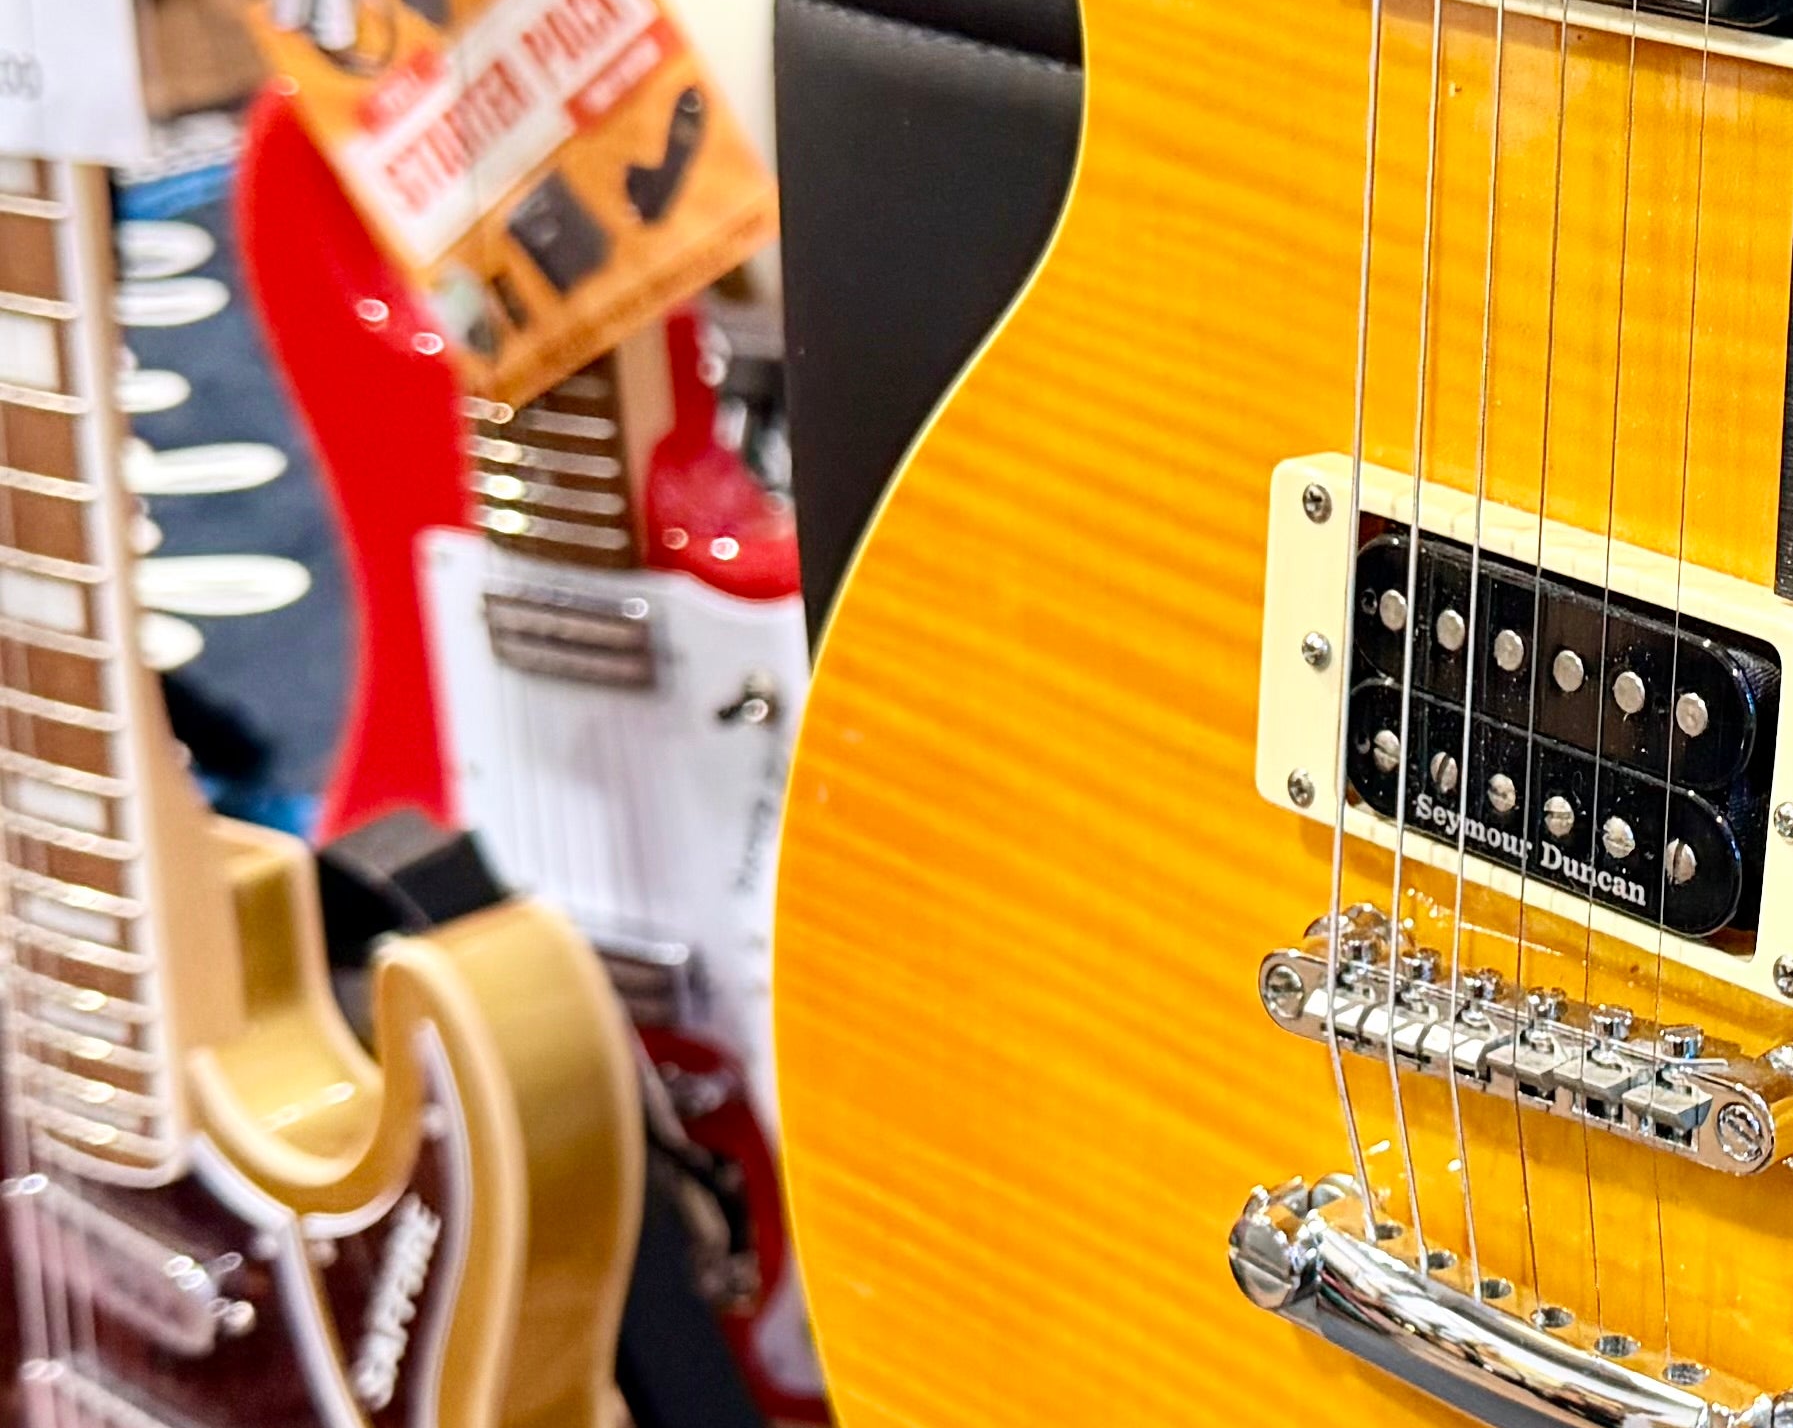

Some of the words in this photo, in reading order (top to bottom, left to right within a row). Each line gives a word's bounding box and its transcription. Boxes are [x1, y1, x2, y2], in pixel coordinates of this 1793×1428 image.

[385, 58, 528, 214] STARTER
[1414, 792, 1533, 861] Seymour
[1540, 839, 1647, 907] Duncan
